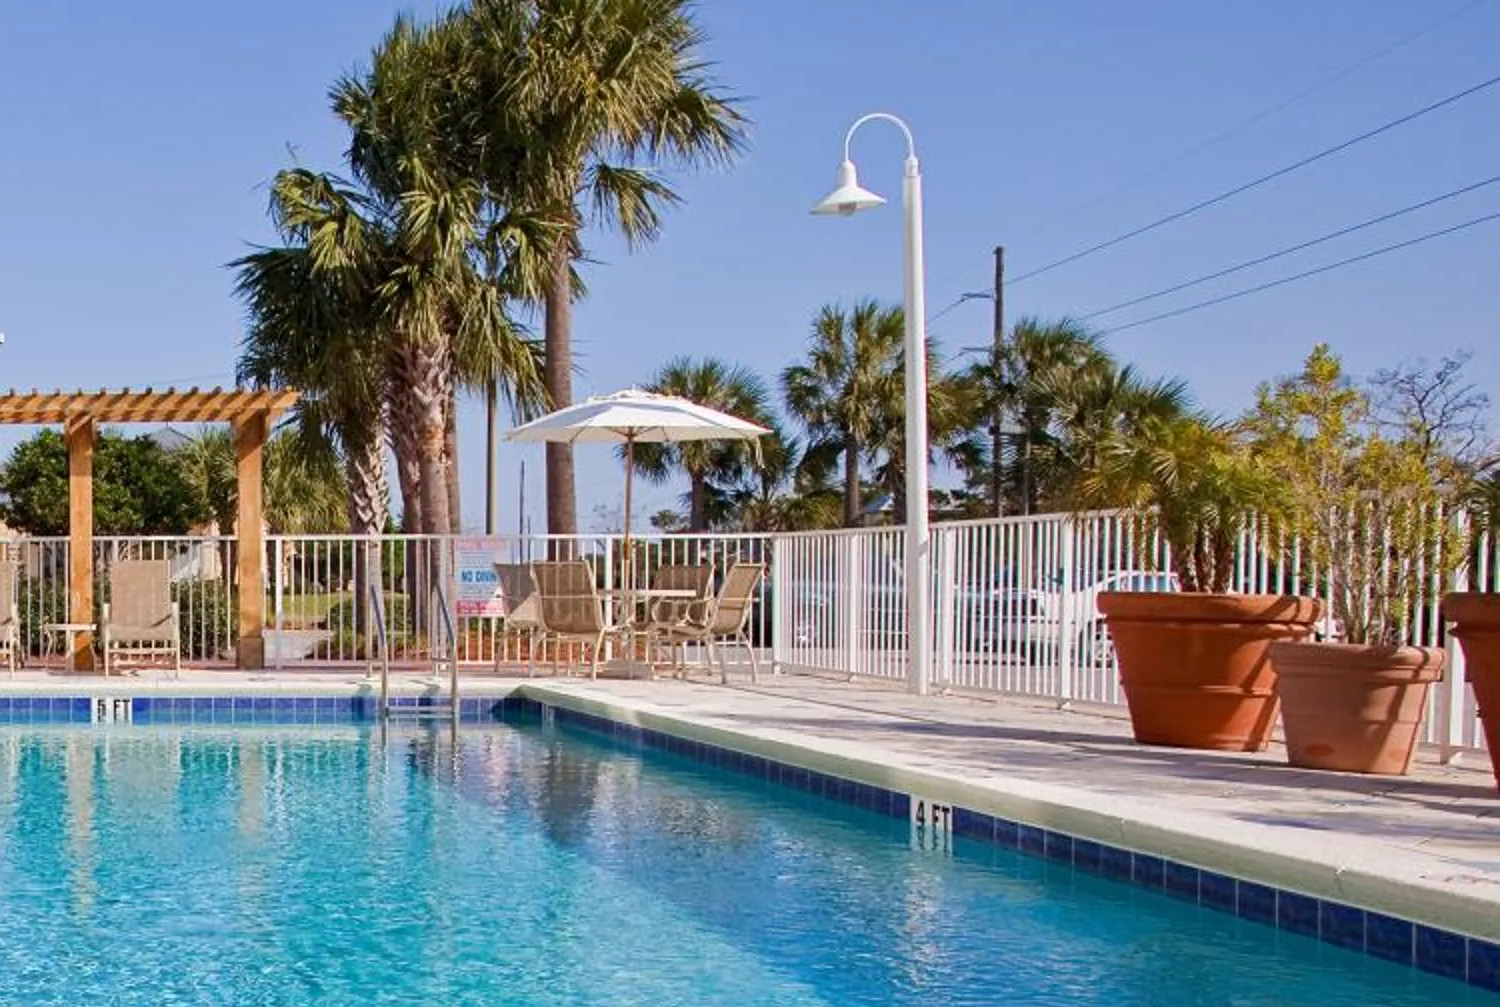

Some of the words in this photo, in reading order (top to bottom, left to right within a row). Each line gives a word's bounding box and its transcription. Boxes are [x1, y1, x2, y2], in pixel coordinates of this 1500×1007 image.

[461, 570, 473, 582] NO
[476, 570, 497, 582] DIVIN
[113, 699, 130, 717] FT
[932, 803, 950, 829] FT
